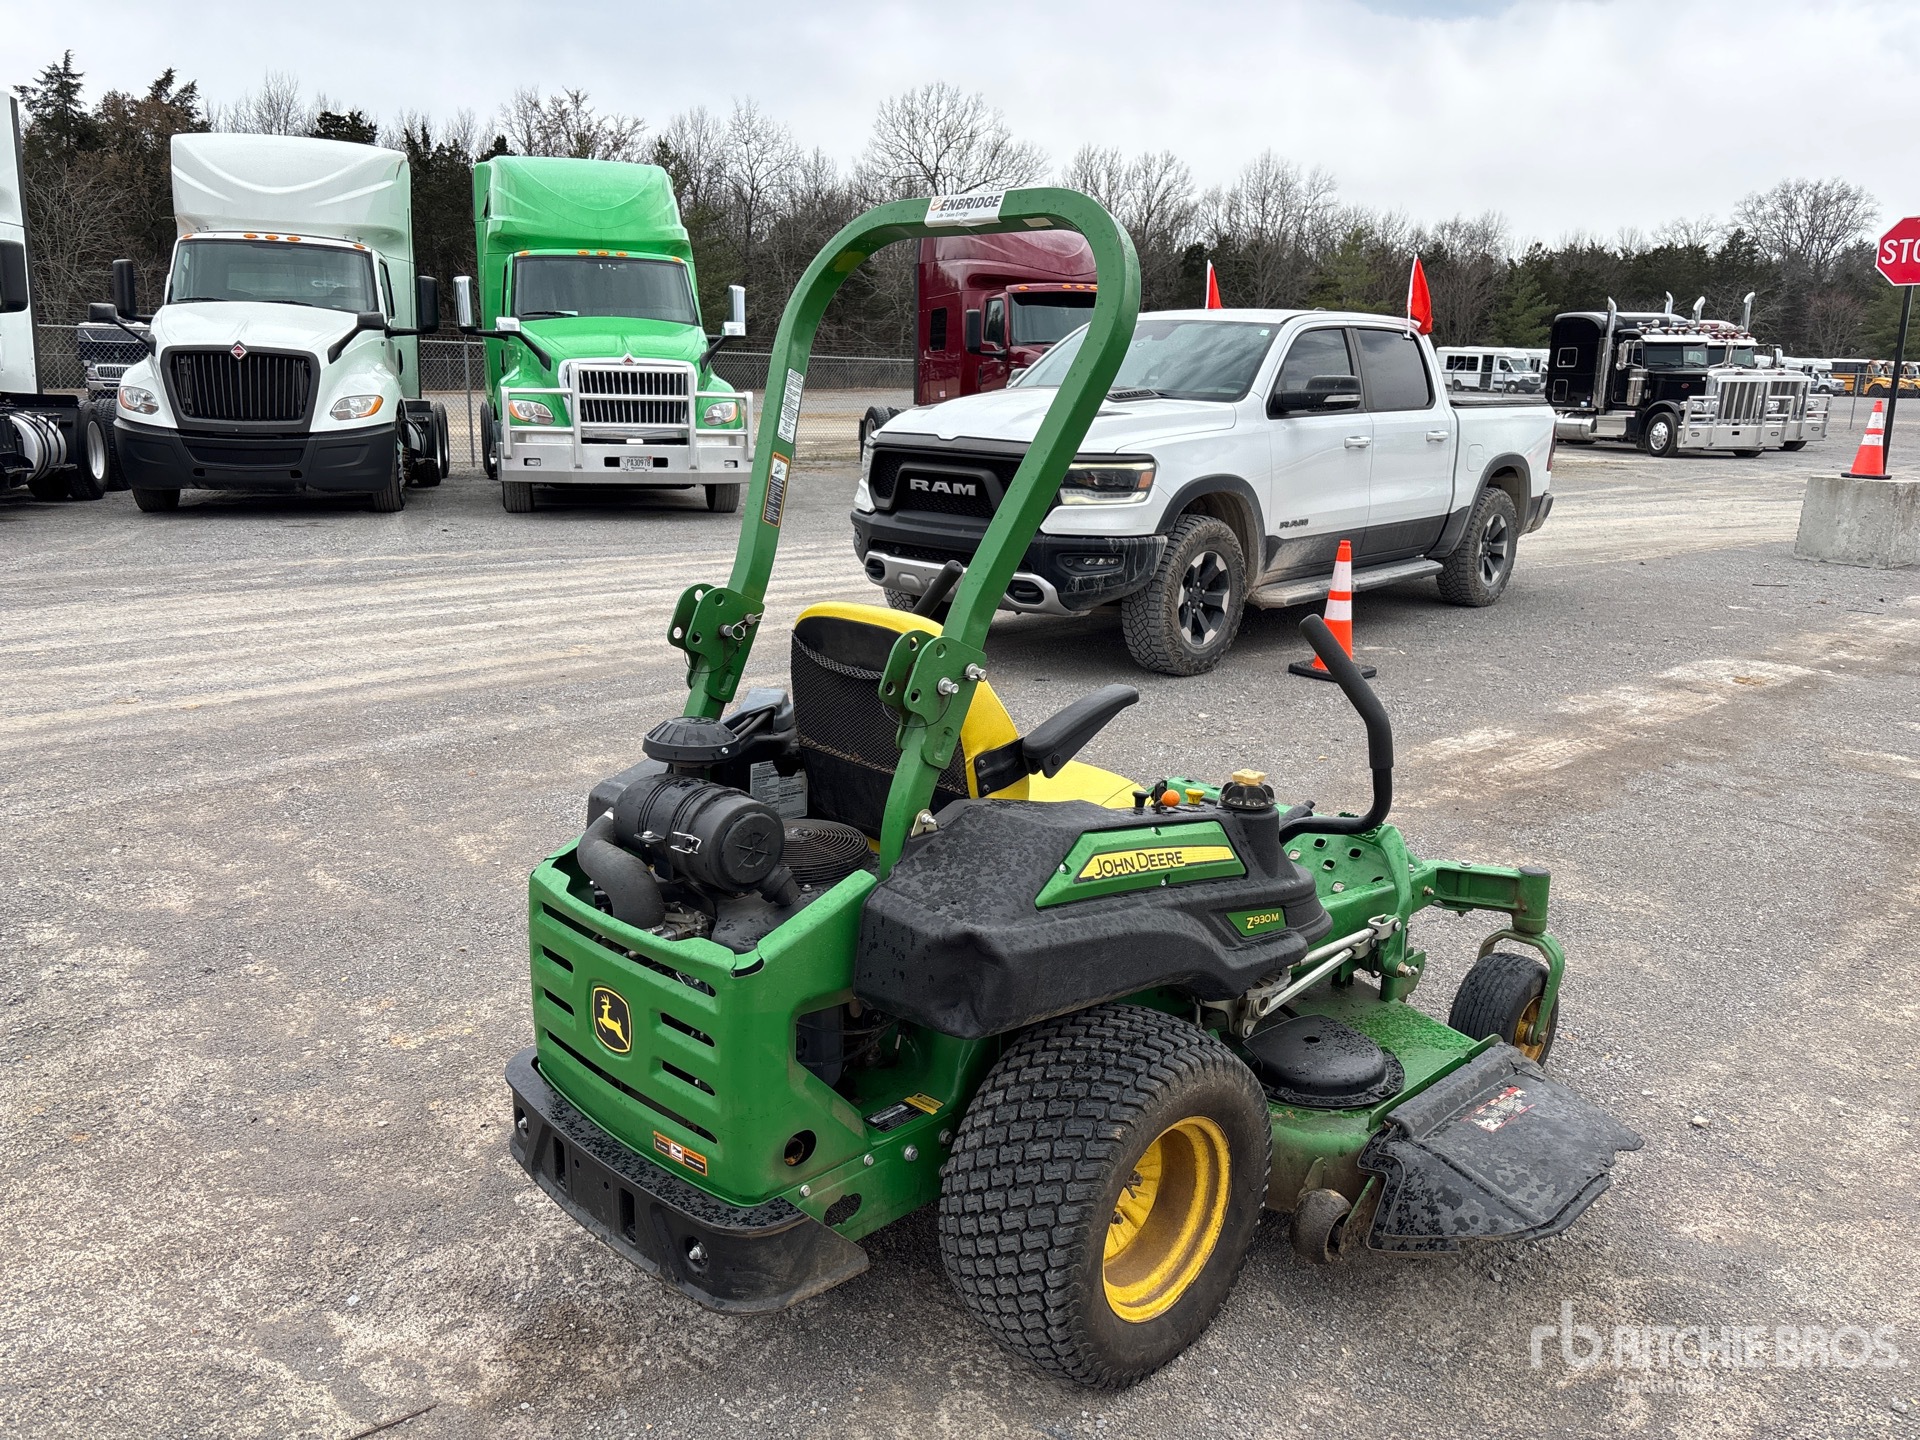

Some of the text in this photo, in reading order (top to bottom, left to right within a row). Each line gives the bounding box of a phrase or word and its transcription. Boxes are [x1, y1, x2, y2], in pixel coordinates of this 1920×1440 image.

[939, 195, 1002, 212] ENBRIDGE
[909, 478, 976, 497] RAM
[1279, 518, 1309, 530] RAM
[1094, 851, 1185, 877] JOHN DEERE
[1246, 912, 1280, 929] Z930M
